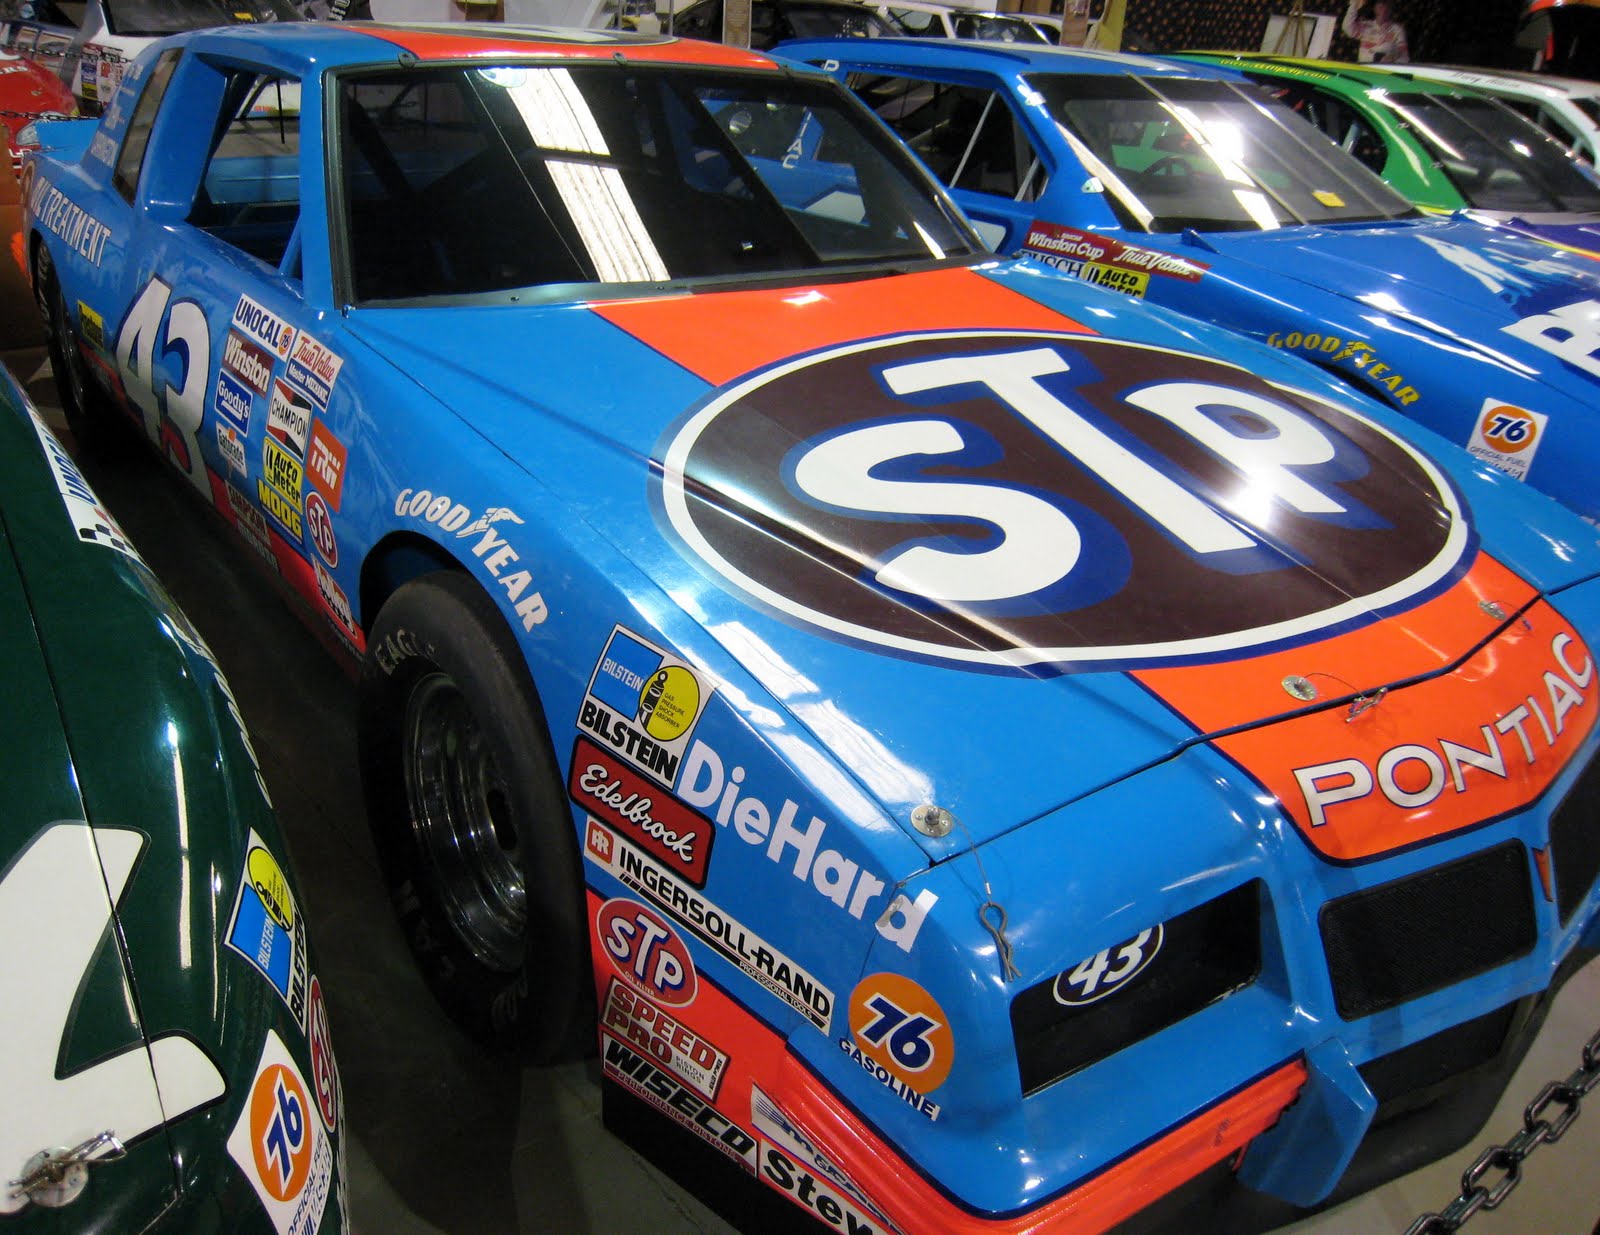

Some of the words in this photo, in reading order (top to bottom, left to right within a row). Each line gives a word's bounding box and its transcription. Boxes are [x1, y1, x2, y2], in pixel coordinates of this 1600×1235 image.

[41, 187, 112, 268] TREATMENT
[1028, 232, 1077, 254] Winston
[1076, 242, 1104, 261] Cup
[1101, 269, 1139, 287] Auto
[235, 299, 282, 348] UNOCAL
[281, 333, 290, 348] 76
[115, 276, 214, 503] 43
[224, 334, 271, 393] Winston
[218, 379, 250, 419] Goody's
[271, 398, 308, 438] CHAMPION
[1486, 414, 1532, 443] 76
[273, 465, 301, 503] Meter
[274, 451, 298, 484] Auto
[311, 436, 341, 489] TRW
[795, 347, 1348, 602] STP
[258, 479, 303, 540] MOOG
[309, 502, 333, 554] STP
[394, 488, 549, 633] GOODYEAR
[602, 657, 645, 692] BILSTEIN
[664, 692, 675, 702] GAS
[656, 711, 680, 728] ABSORBER
[658, 704, 674, 717] SHOCK
[661, 698, 685, 716] PRESSURE
[1292, 631, 1593, 828] PONTIAC
[580, 700, 679, 782] BILSTEIN
[580, 764, 696, 862] Edelbrock
[677, 738, 939, 954] DieHard
[257, 913, 276, 970] BILSTEIN
[606, 912, 686, 993] STP
[620, 847, 831, 1017] INGERSOLL-RAND
[624, 970, 636, 985] OIL
[740, 961, 788, 1000] PROFESSIONAL
[790, 1000, 813, 1019] TOOLS
[1068, 927, 1153, 997] 43
[605, 1004, 673, 1064] PRO
[611, 984, 717, 1071] SPEED
[857, 992, 943, 1073] 76
[676, 1055, 704, 1080] PISTON
[676, 1061, 701, 1084] RINGS
[839, 1037, 939, 1122] GASOLINE
[605, 1040, 755, 1156] WISECO
[617, 1070, 691, 1125] PERFORMANCE
[692, 1122, 737, 1158] PISTONS
[264, 1074, 304, 1192] 76
